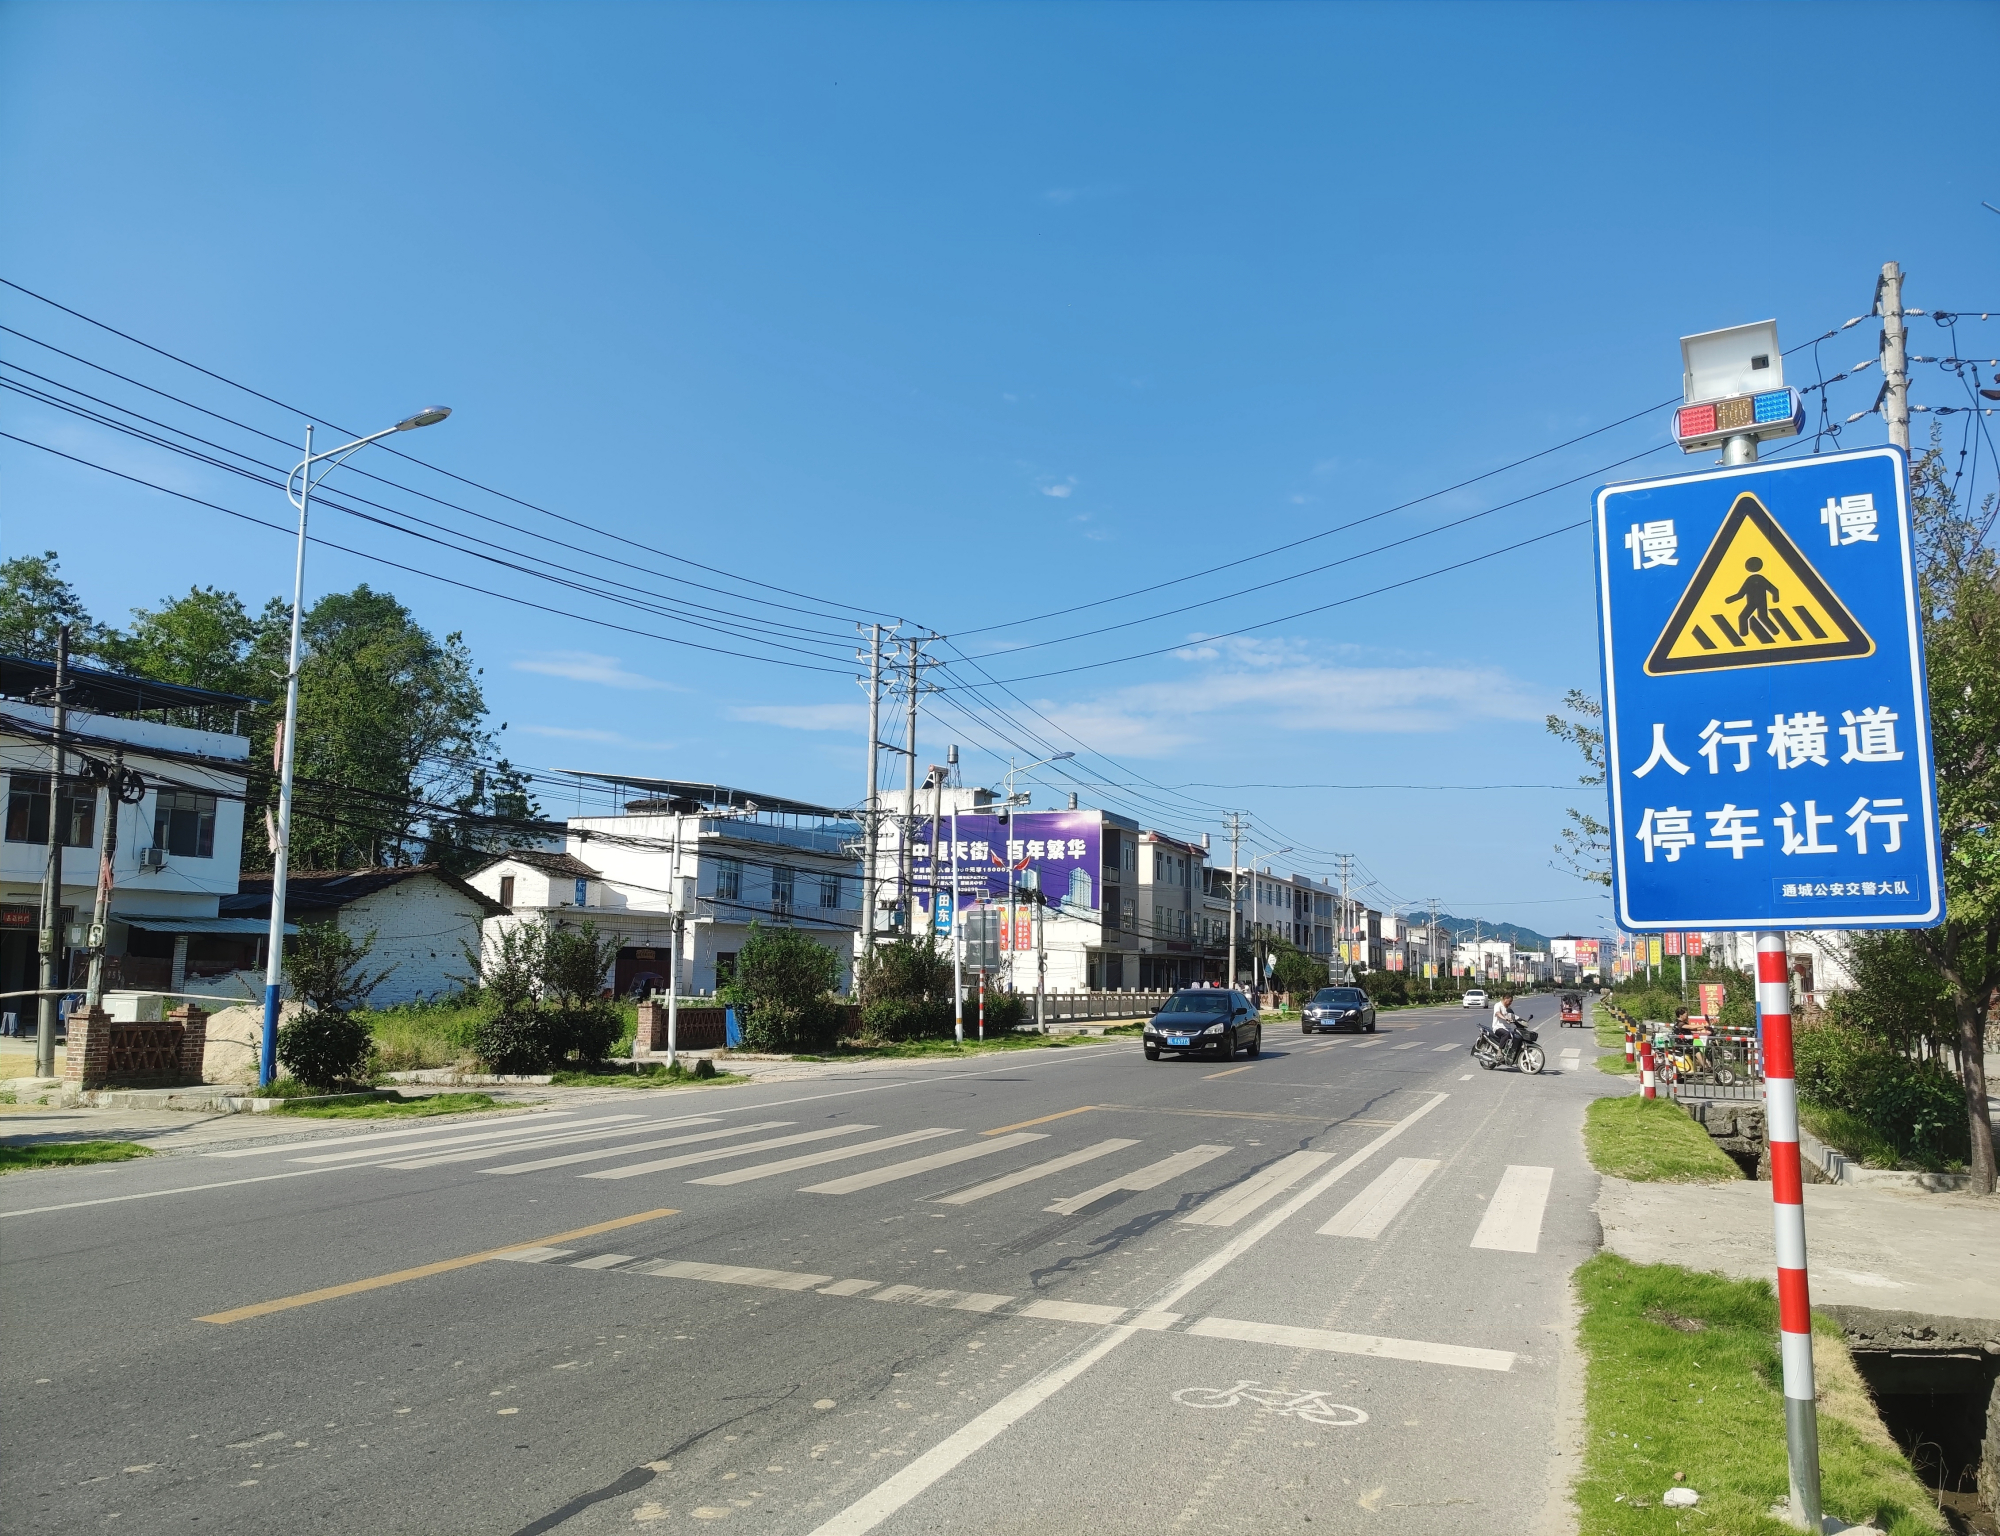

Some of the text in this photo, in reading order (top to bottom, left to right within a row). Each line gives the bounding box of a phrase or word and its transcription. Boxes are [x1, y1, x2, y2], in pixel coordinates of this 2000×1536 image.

[1624, 519, 1680, 571] 慢
[1820, 493, 1880, 547] 慢
[1632, 706, 1904, 779] 人行横道
[1006, 839, 1086, 860] 百年繁华
[1635, 796, 1909, 863] 停车让行
[937, 894, 950, 922] 田东
[1782, 881, 1910, 897] 通城公安交警大队
